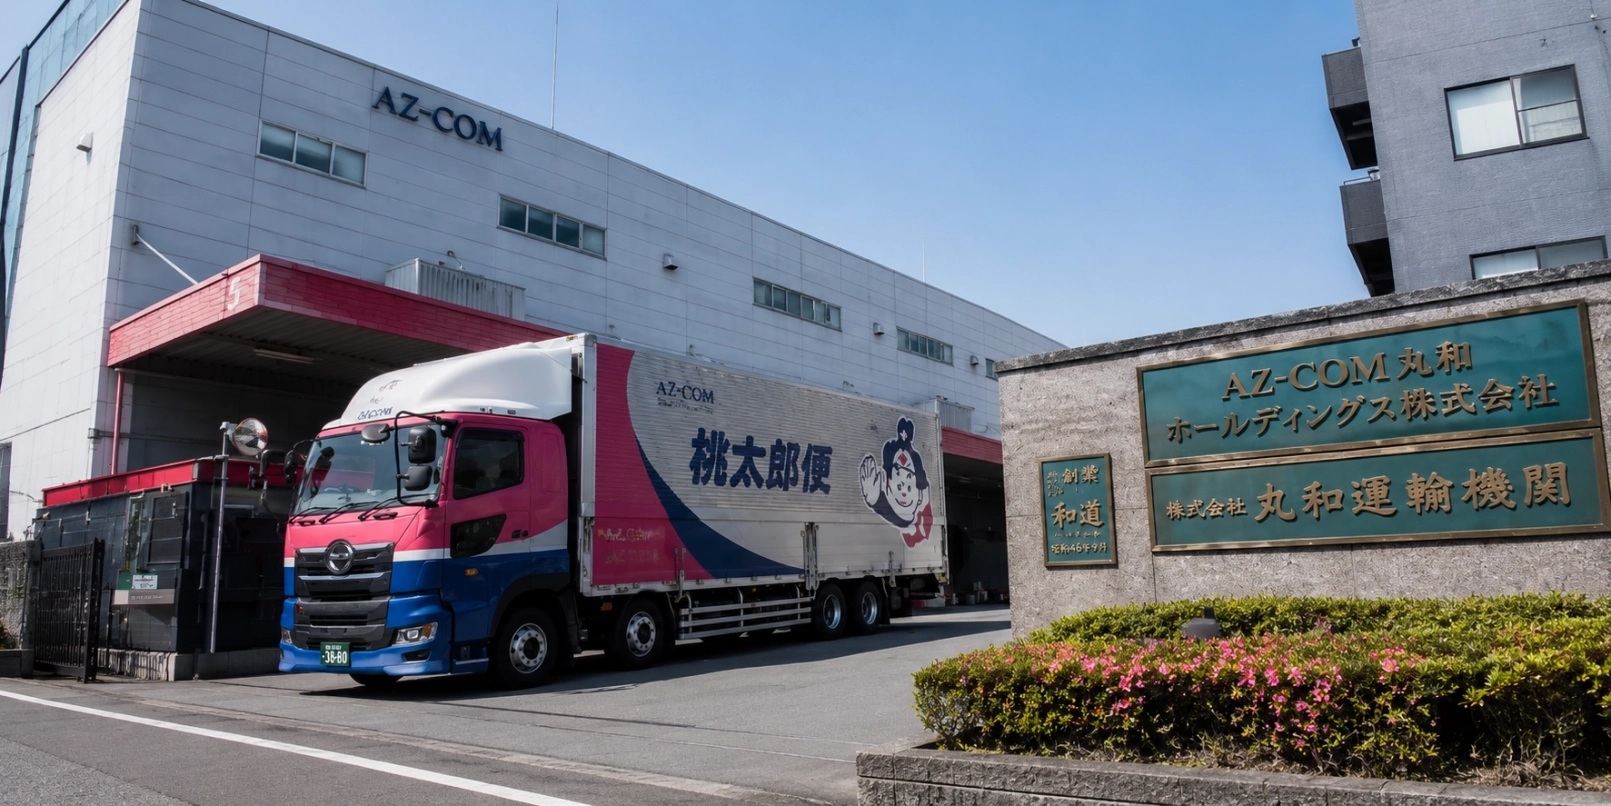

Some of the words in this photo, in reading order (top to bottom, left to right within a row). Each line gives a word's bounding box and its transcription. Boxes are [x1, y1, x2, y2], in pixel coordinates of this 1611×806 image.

[371, 86, 503, 152] AZ-COM
[227, 276, 241, 311] 5
[656, 380, 715, 404] AZ-COM
[1166, 373, 1560, 443] ホールディングス株式会社
[689, 427, 833, 495] 桃太郎便
[1051, 499, 1105, 530] 和道
